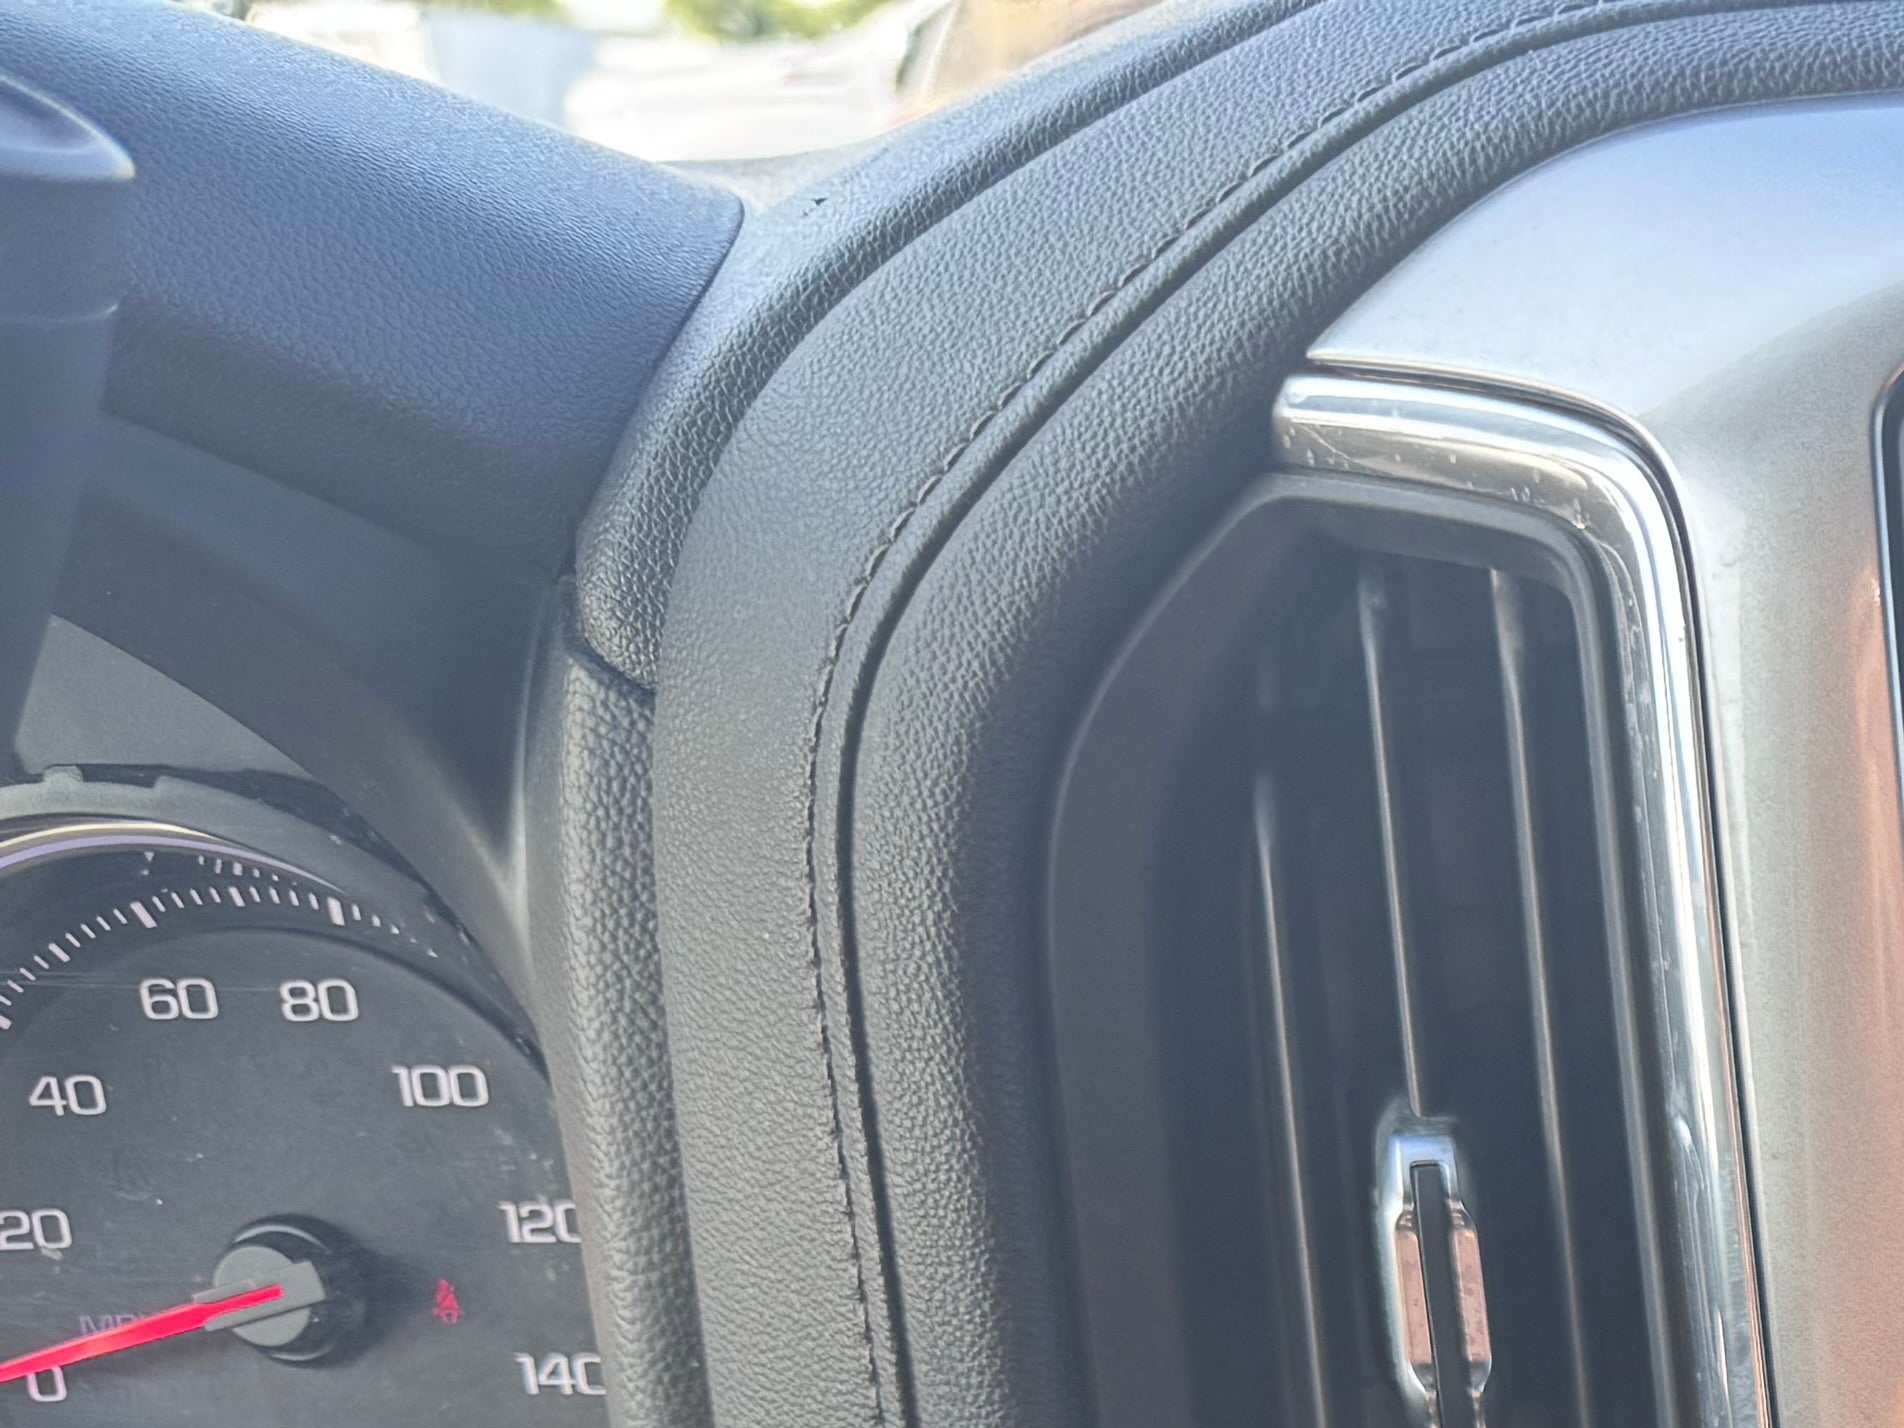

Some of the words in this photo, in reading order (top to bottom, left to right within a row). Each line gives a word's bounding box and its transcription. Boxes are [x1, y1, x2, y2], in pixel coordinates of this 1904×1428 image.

[139, 977, 219, 1021] 60
[280, 978, 359, 1022] 80
[28, 1074, 107, 1117] 40
[391, 1065, 490, 1108] 100
[0, 1208, 72, 1250] 20
[514, 1352, 607, 1396] 140
